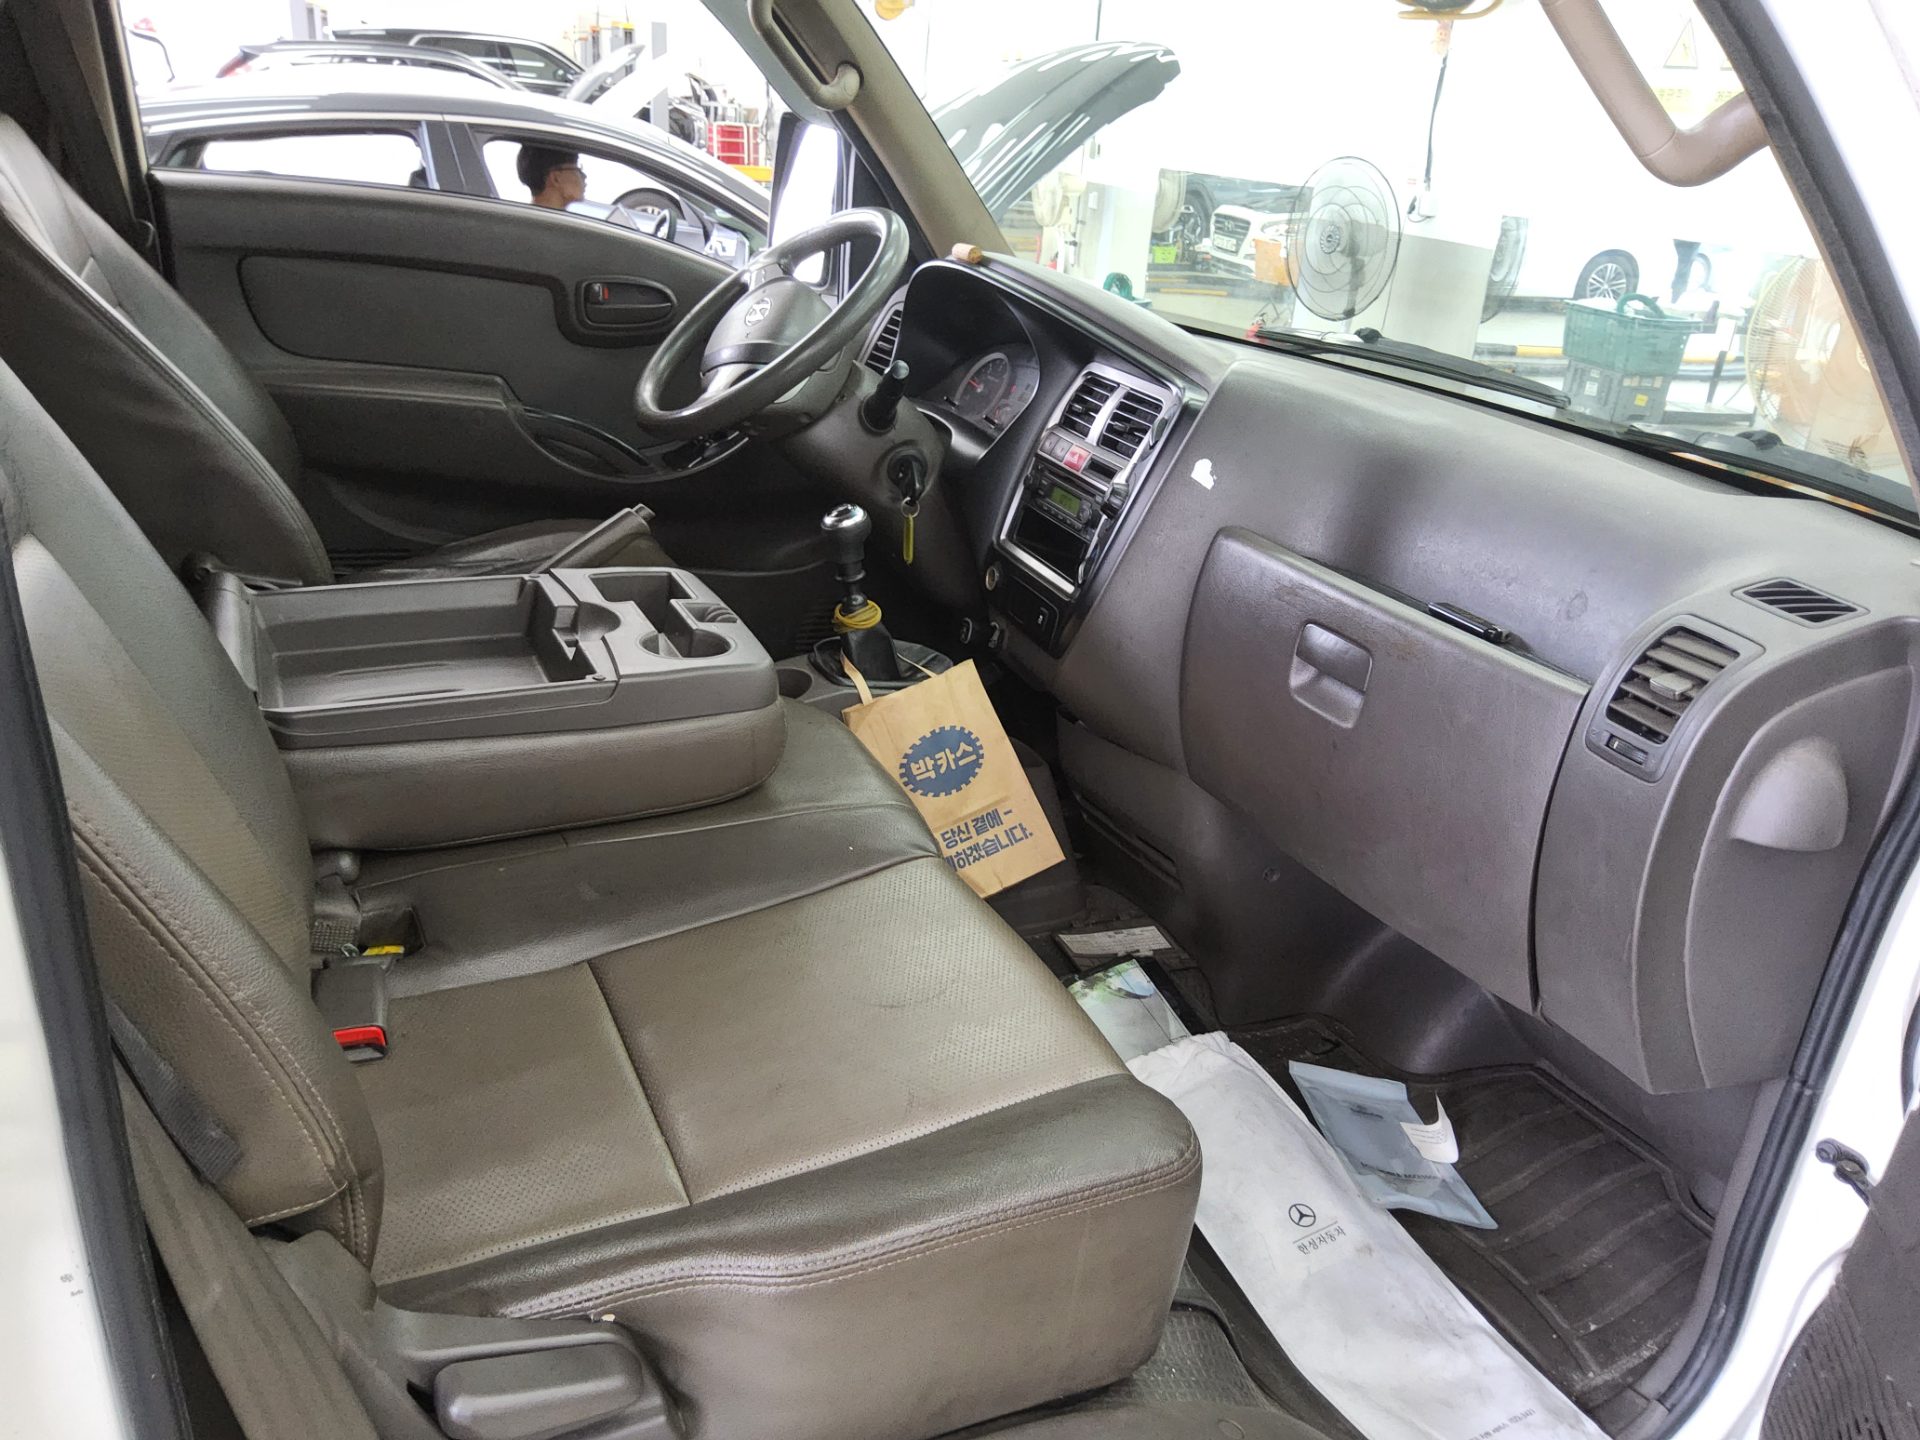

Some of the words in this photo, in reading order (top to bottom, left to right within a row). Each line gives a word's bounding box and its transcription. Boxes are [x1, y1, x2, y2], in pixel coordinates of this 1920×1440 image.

[910, 742, 977, 781] 박카스
[940, 822, 972, 849] 당신
[971, 808, 1003, 836] 곁에
